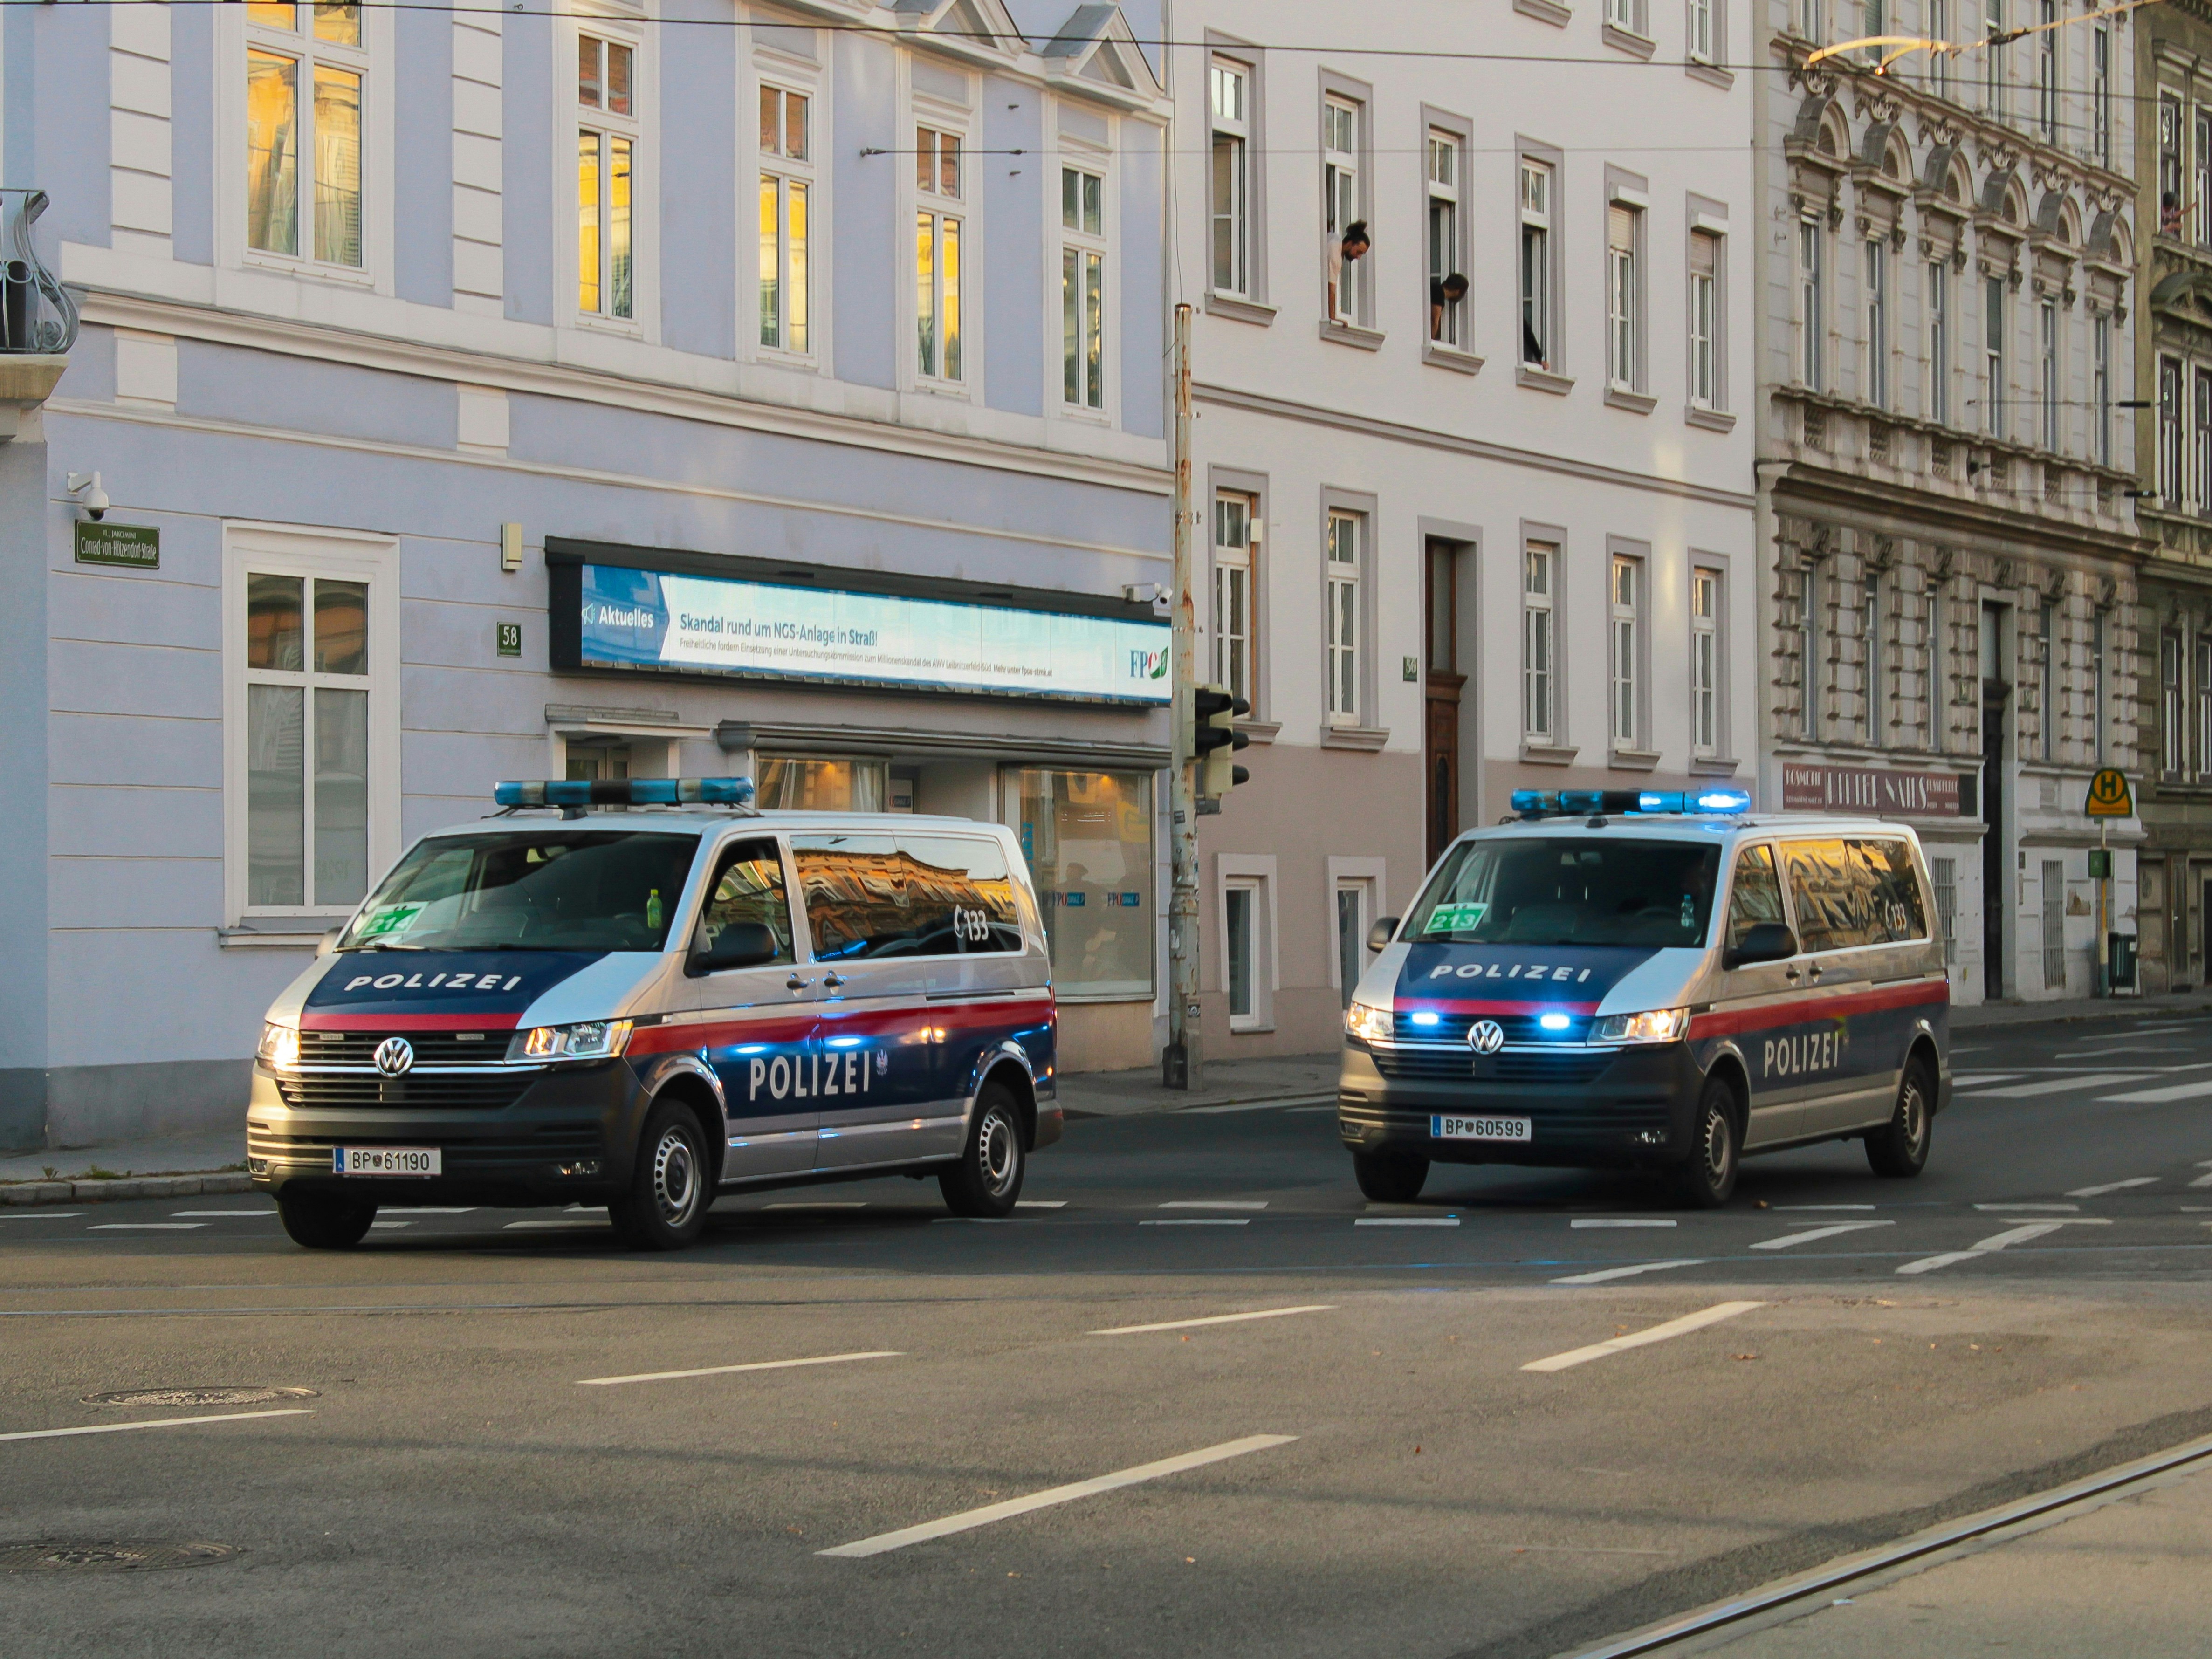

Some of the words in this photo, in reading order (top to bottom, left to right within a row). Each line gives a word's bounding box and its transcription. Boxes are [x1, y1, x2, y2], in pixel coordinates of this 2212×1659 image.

[111, 530, 136, 539] JAKOMINI
[599, 605, 653, 628] Aktuelles
[503, 626, 517, 646] 58
[680, 613, 723, 634] Skandal
[727, 618, 751, 636] rund
[755, 624, 771, 638] um
[774, 622, 835, 646] NGS-Anlage
[837, 626, 846, 644] in
[849, 628, 878, 647] Straß!
[680, 638, 717, 650] Freiheitliche
[718, 640, 740, 652] fordern
[741, 642, 772, 657] Einsetzung
[773, 645, 788, 656] einer
[789, 647, 863, 662] Untersuchungskommission
[877, 654, 921, 667] Millionenskandal
[922, 657, 931, 667] des
[994, 663, 1007, 673] Mehr
[1007, 665, 1021, 674] unter
[2101, 775, 2116, 797] H
[963, 910, 989, 941] 133
[1431, 913, 1476, 929] 213
[1890, 902, 1907, 932] 133
[344, 973, 522, 991] POLIZEI
[1430, 964, 1591, 983] POLIZEI
[1764, 1031, 1839, 1078] POLIZEI
[749, 1050, 870, 1101] POLIZEI
[1446, 1118, 1463, 1135] BP
[1476, 1120, 1524, 1137] 60599
[352, 1152, 371, 1169] BP
[384, 1152, 429, 1171] 61190
